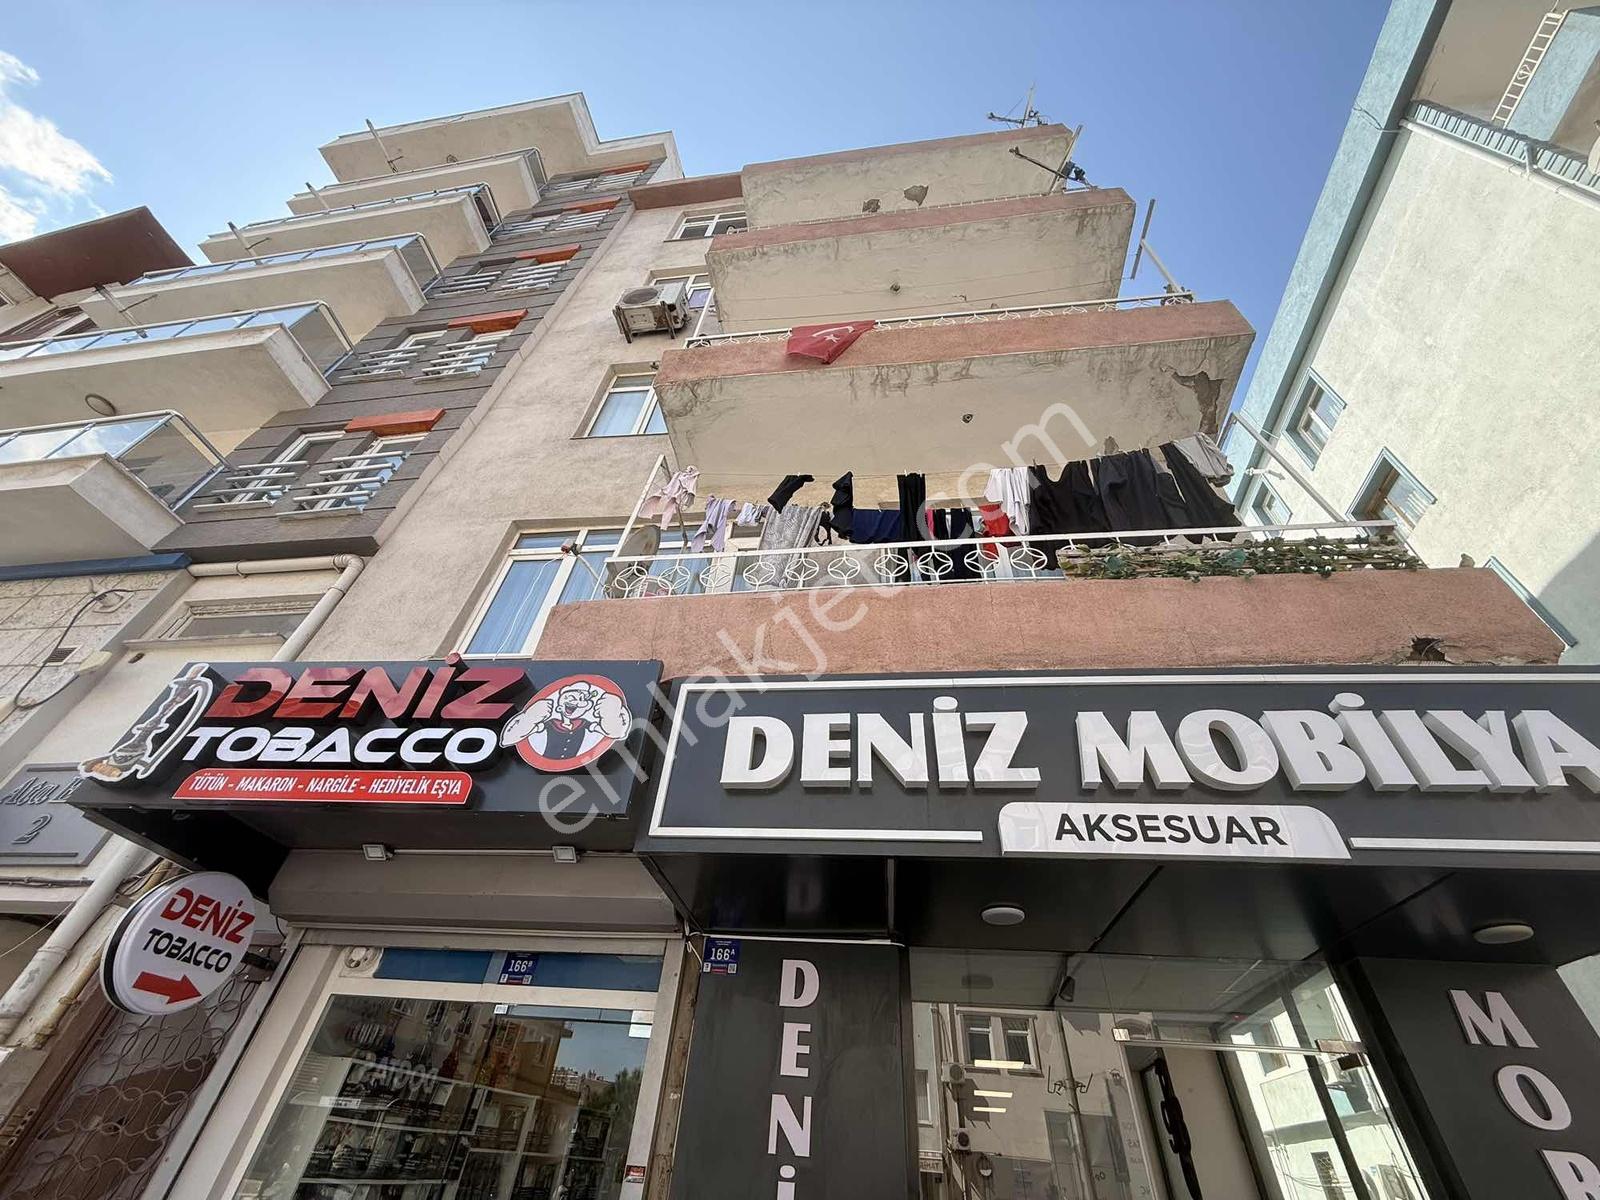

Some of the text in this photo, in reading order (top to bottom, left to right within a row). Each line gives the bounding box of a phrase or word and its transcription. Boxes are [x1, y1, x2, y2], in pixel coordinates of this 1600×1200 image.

[204, 653, 527, 720] DENİZ
[182, 726, 499, 765] TOBACCO
[719, 692, 1600, 794] DENİZ MOBİLYA
[188, 773, 227, 791] TÜTÜN
[236, 775, 298, 793] MAKARON
[305, 774, 358, 794] NARGİLE
[368, 775, 429, 795] HEDİYELİK
[431, 778, 463, 799] EŞYA
[11, 813, 53, 845] 2
[1053, 812, 1288, 846] AKSESUAR
[160, 887, 256, 944] DENİZ
[142, 927, 232, 973] TOBACCO
